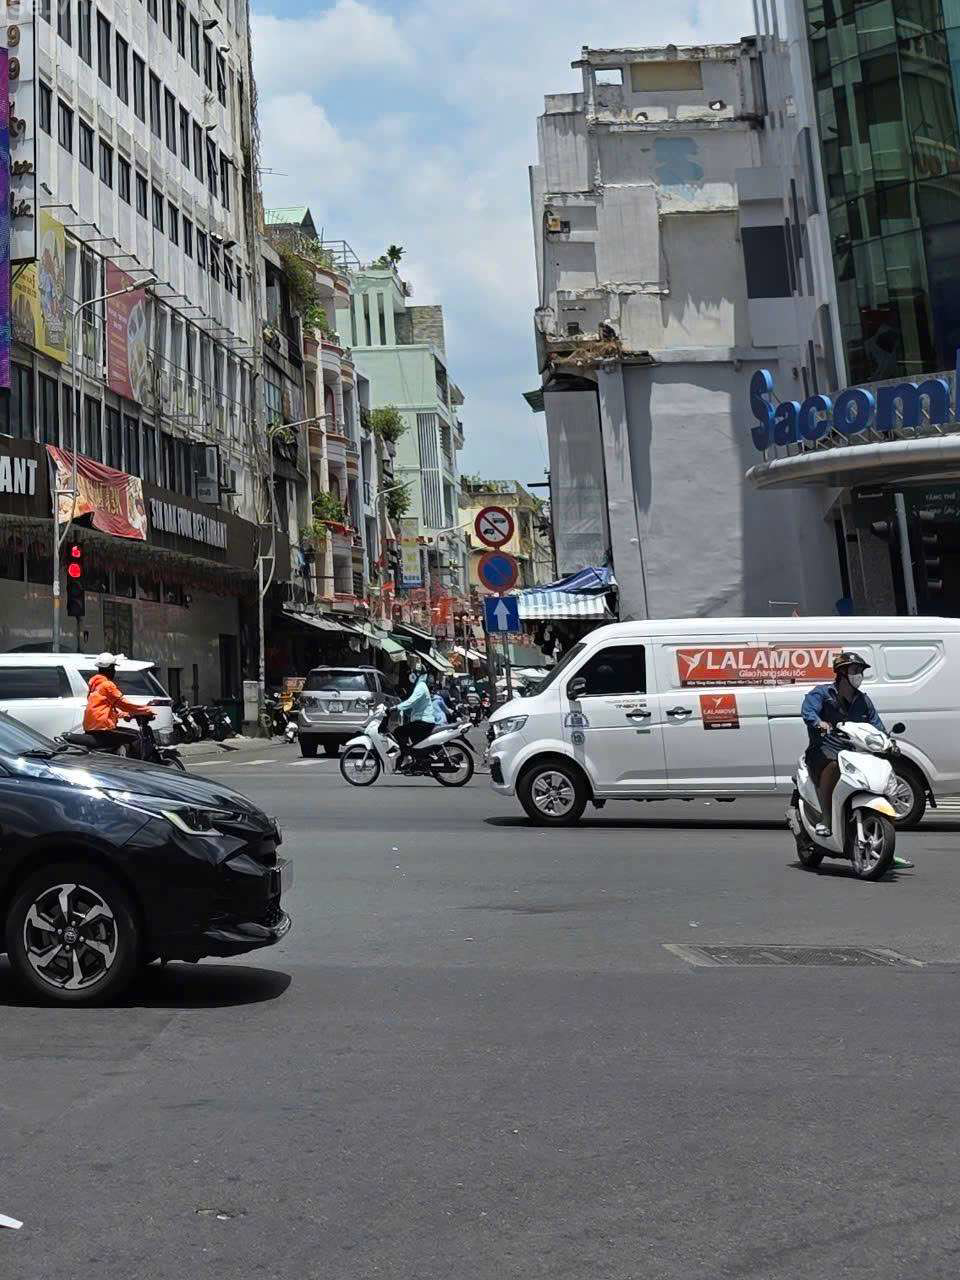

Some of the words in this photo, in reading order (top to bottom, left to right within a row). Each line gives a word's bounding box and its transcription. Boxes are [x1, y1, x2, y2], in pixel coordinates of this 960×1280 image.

[750, 353, 960, 451] Sacom
[739, 669, 756, 678] Giao
[756, 668, 777, 679] hàng
[791, 668, 806, 677] tốc
